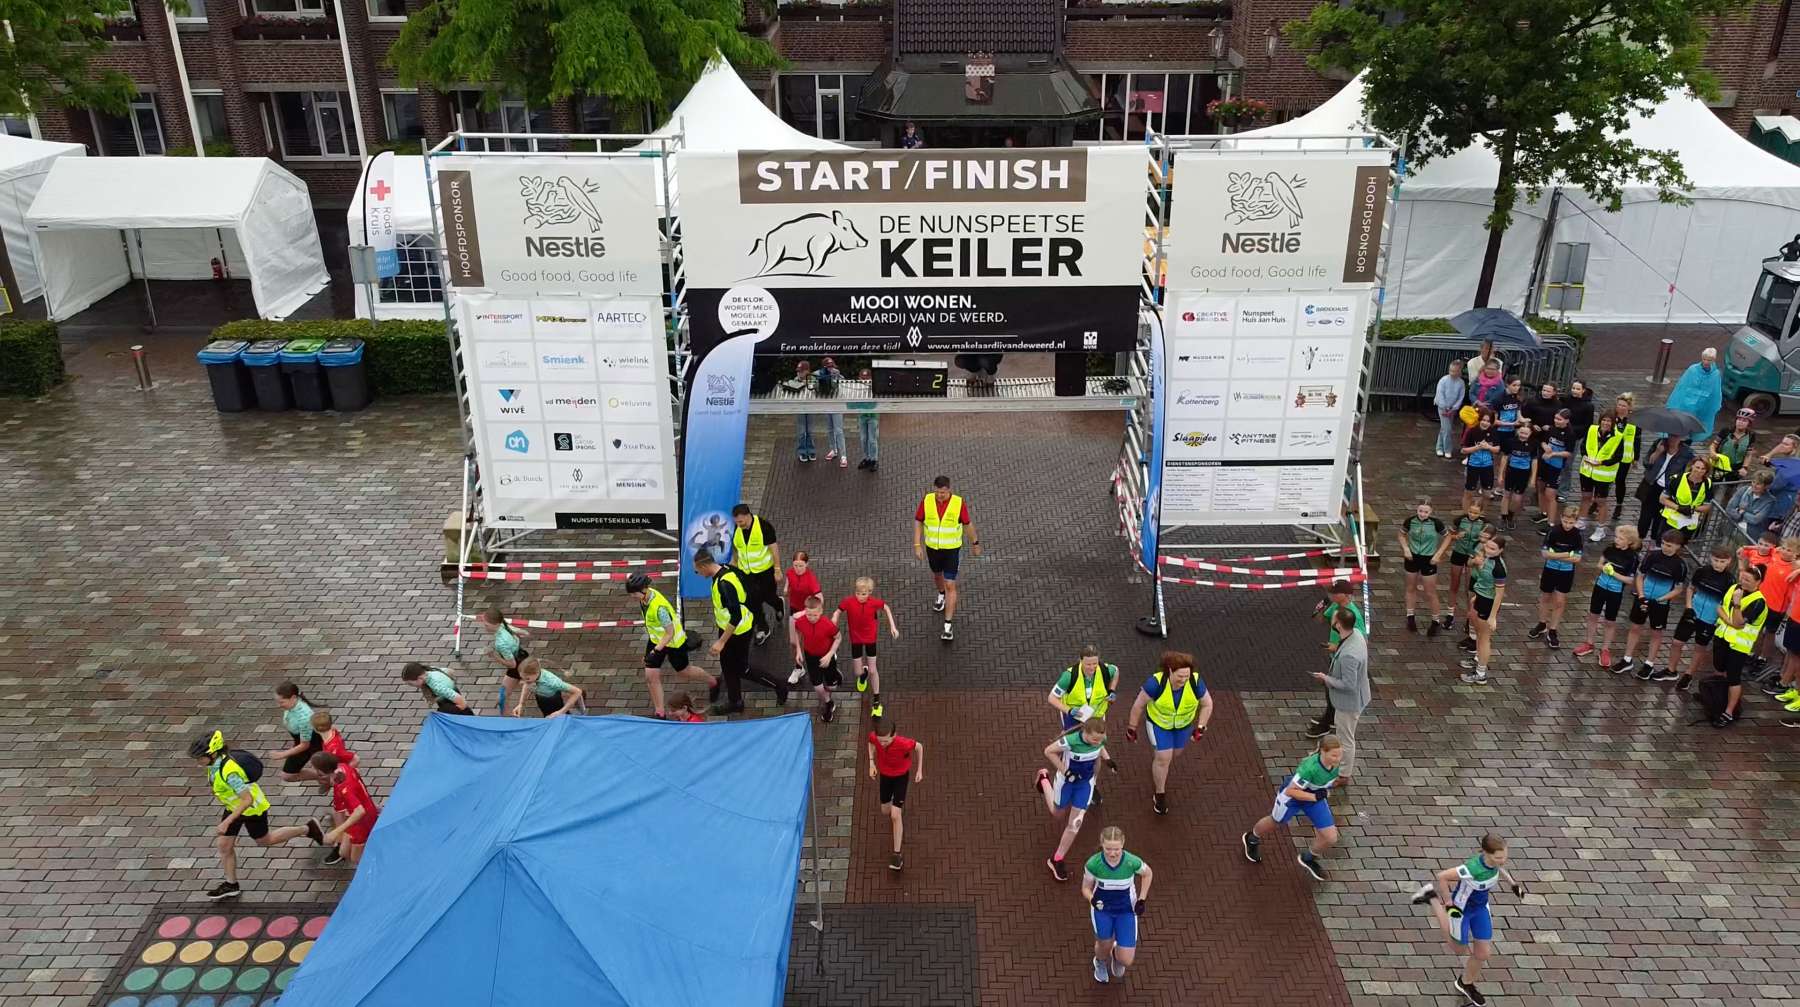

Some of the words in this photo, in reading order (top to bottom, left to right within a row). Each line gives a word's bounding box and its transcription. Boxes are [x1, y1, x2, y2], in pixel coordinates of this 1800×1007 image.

[370, 207, 380, 236] Kruis
[383, 206, 392, 235] Rode
[879, 215, 911, 233] DE
[920, 213, 1085, 234] NUNSPEETSE
[1355, 176, 1377, 273] HOOFDSPONSOR
[454, 180, 471, 278] HOOFDSPONSOR
[880, 238, 1084, 278] KEILER
[500, 269, 537, 282] Good
[541, 269, 575, 283] food,
[579, 270, 615, 283] Good
[619, 270, 638, 282] life
[1190, 265, 1227, 278] Good
[1231, 265, 1264, 280] food,
[1268, 265, 1304, 278] Good
[1308, 265, 1327, 277] life
[850, 296, 899, 309] MOOI
[904, 295, 977, 309] WONEN.
[822, 313, 906, 326] MAKELAARDIJ
[910, 313, 936, 323] VAN
[939, 313, 956, 323] DE
[960, 312, 1008, 323] WEERD.
[1242, 310, 1275, 318] Nunspeet
[780, 343, 797, 351] Een
[799, 343, 841, 351] makelaar
[861, 343, 881, 351] deze
[927, 340, 1066, 350] www.makelaardijvandeweerd.nl
[619, 356, 649, 365] wielink
[931, 374, 943, 389] 2
